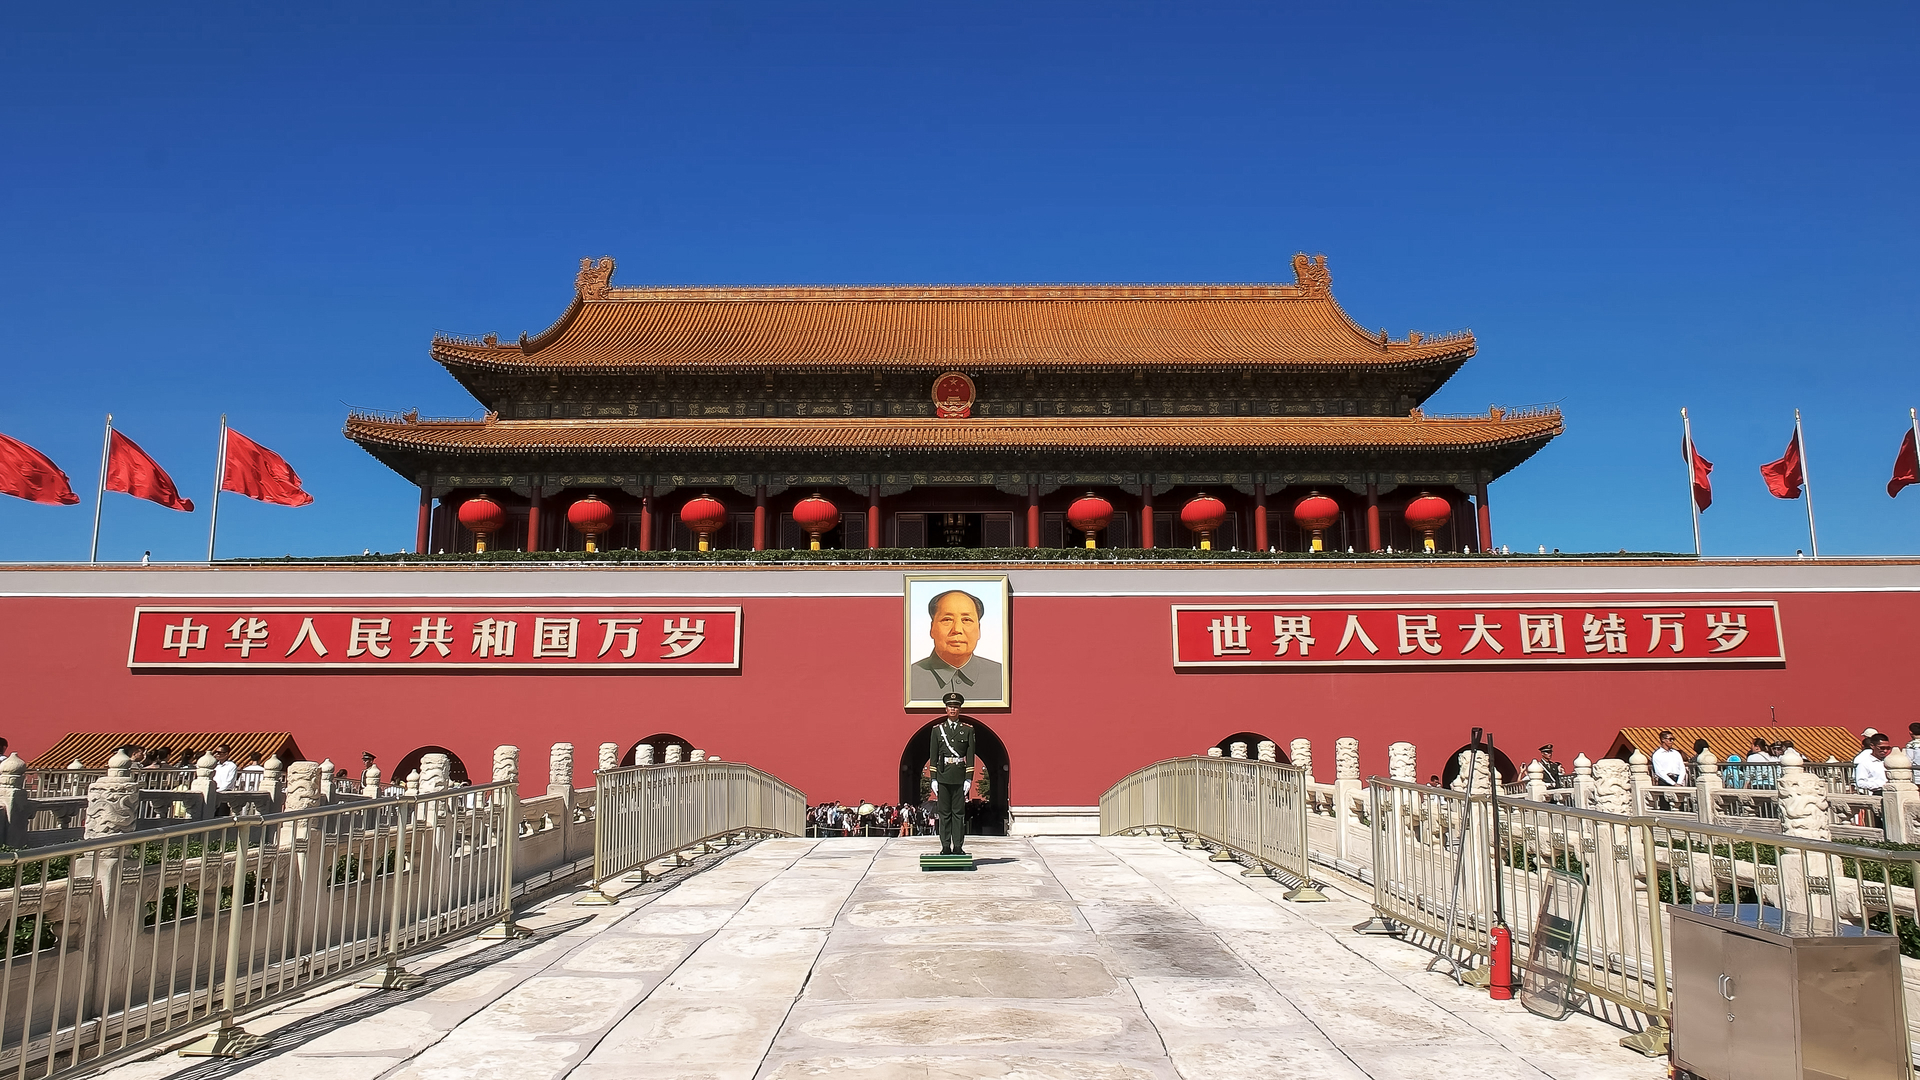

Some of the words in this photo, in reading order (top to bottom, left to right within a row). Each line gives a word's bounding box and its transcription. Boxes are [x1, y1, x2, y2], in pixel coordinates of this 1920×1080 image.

[162, 616, 707, 659] 中华人民共和国万岁
[1207, 612, 1750, 656] 世界人民大团结万岁
